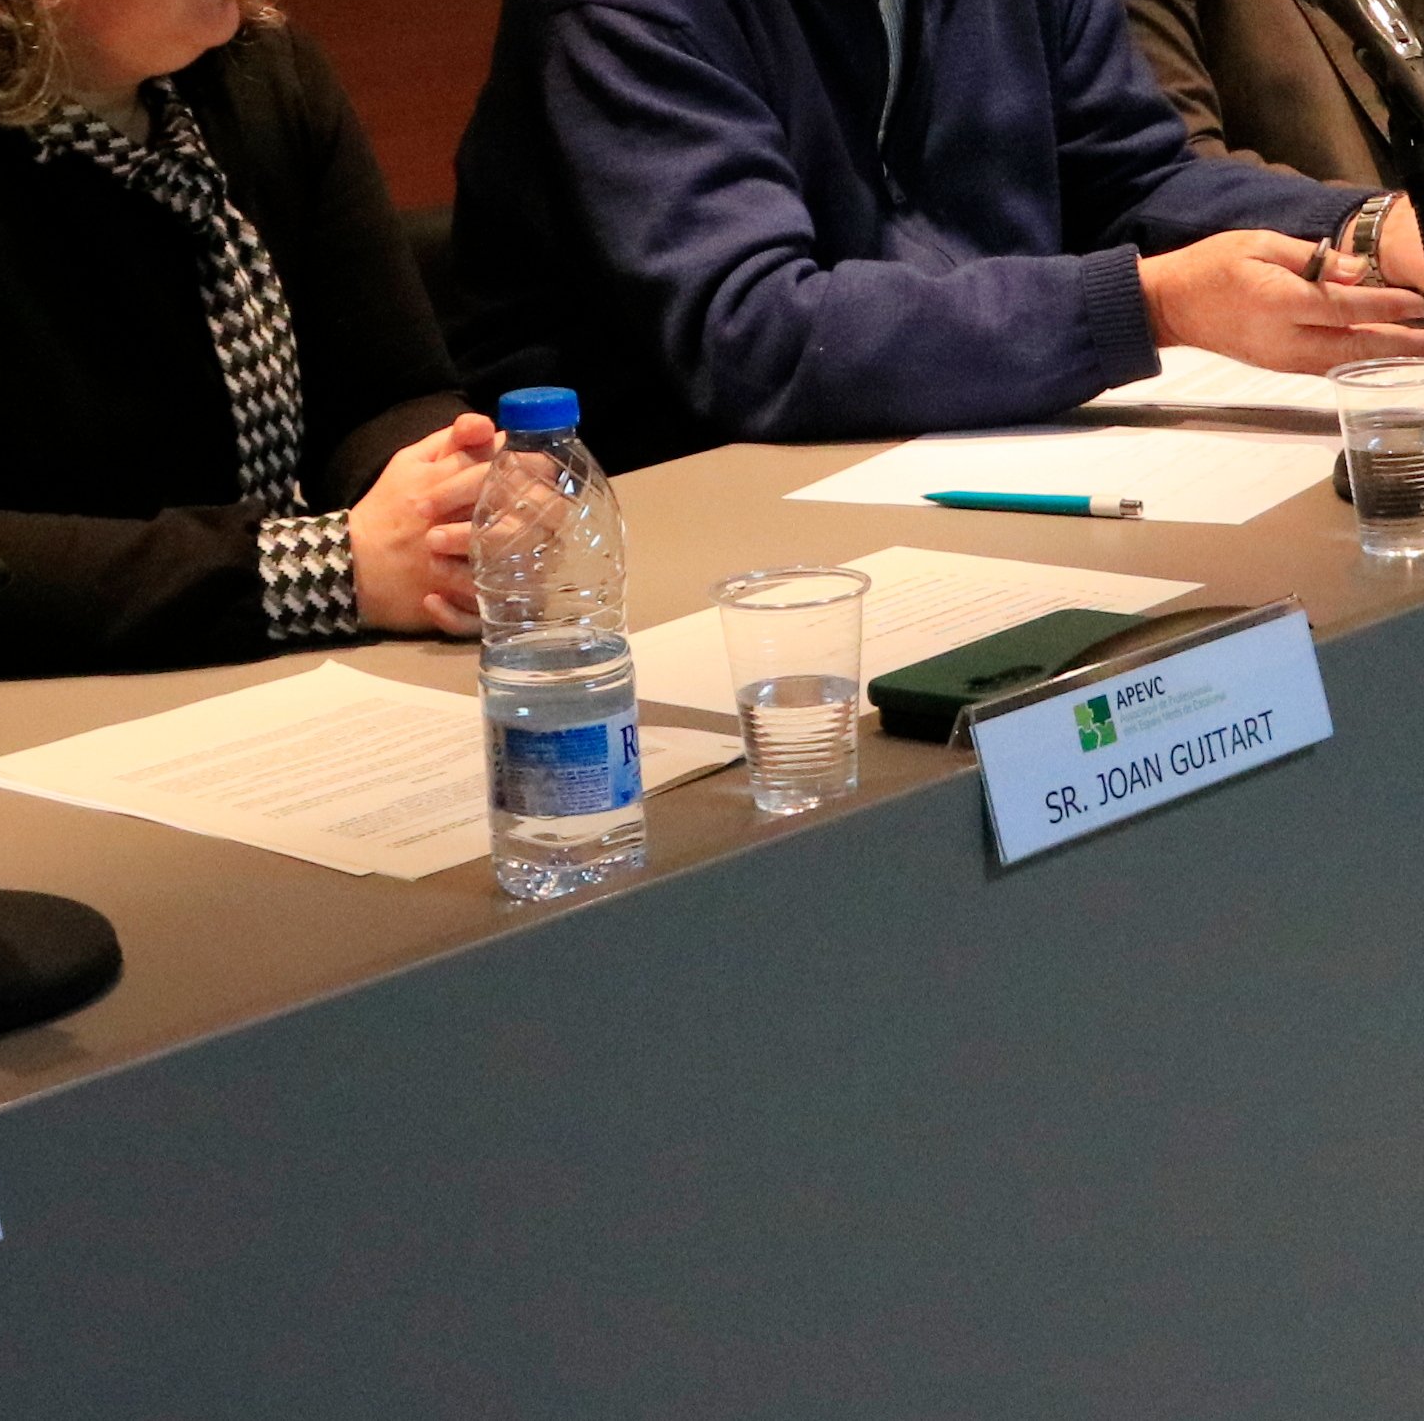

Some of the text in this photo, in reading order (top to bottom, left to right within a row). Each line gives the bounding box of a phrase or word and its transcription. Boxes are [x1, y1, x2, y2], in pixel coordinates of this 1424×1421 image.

[1117, 676, 1165, 710] APEVC
[1045, 710, 1274, 824] SR. JOAN GUITART
